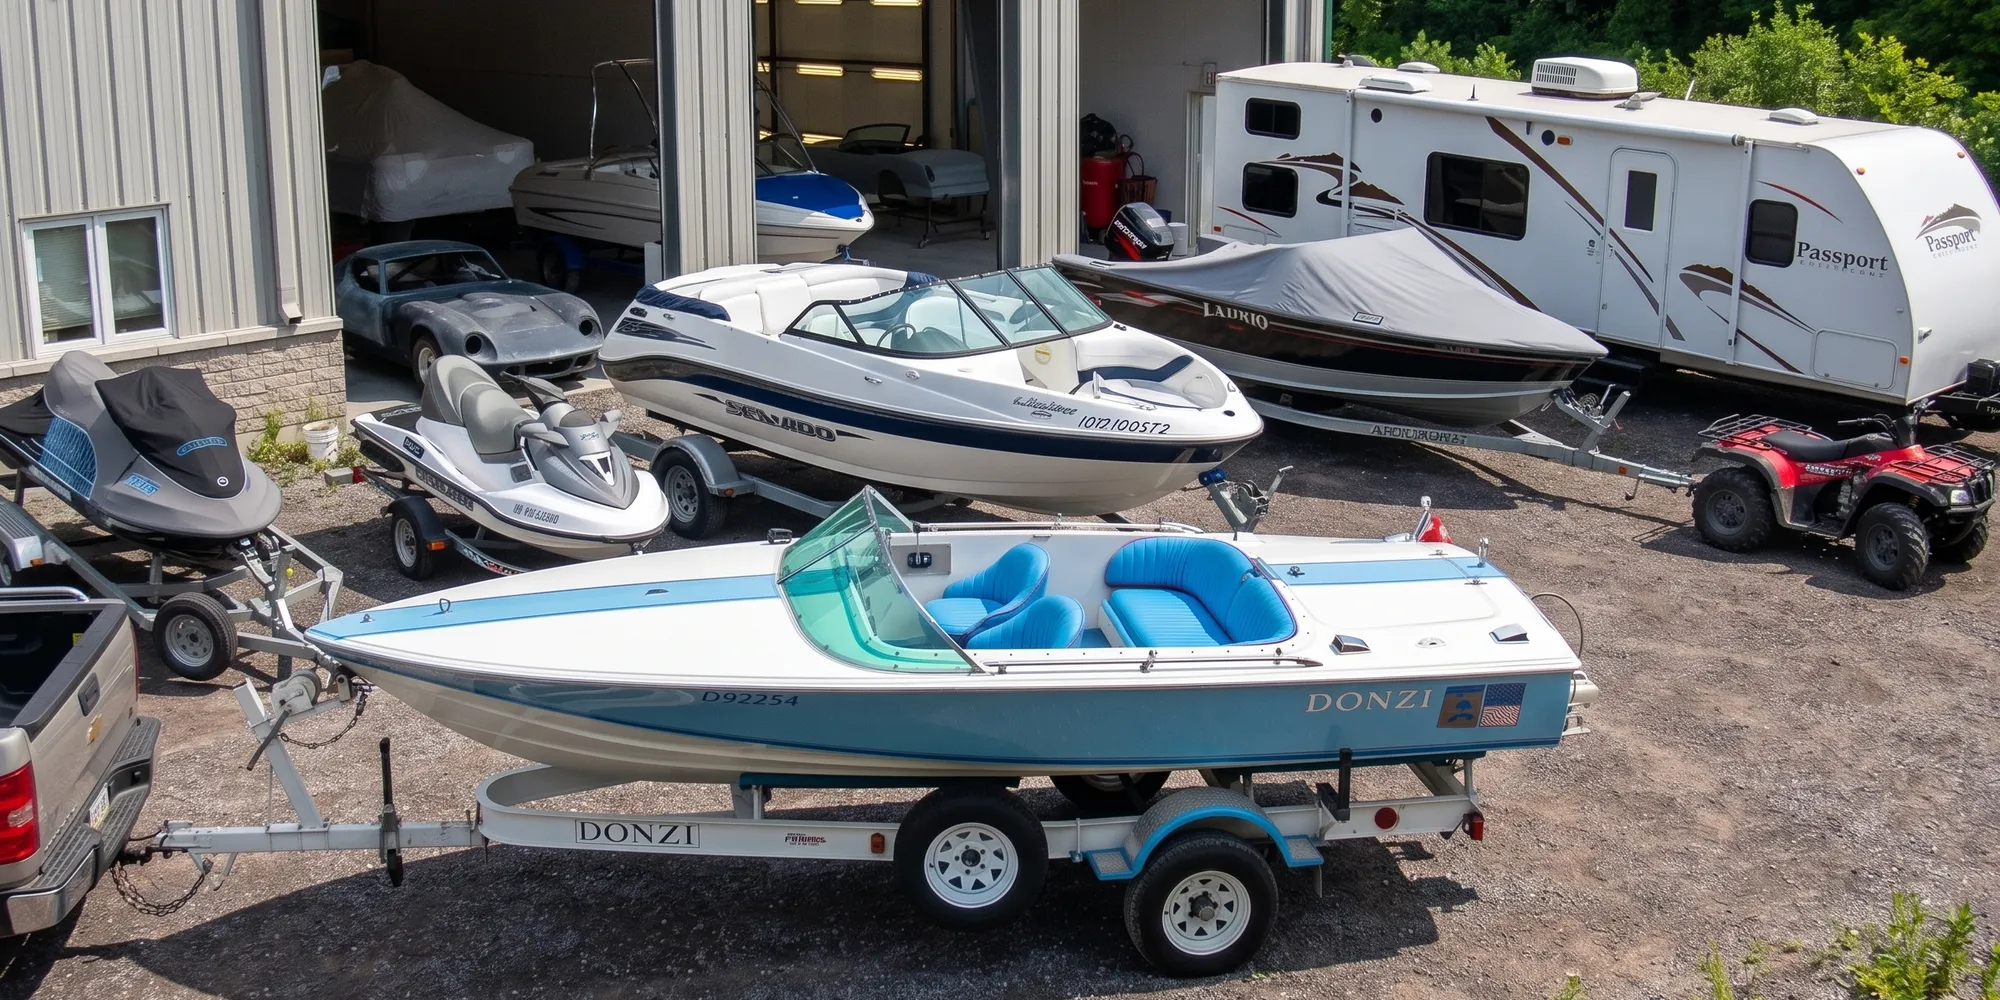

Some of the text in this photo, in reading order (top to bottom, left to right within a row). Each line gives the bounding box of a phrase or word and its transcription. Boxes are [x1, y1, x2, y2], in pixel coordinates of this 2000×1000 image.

[1797, 241, 1889, 272] Passport
[701, 691, 799, 707] D92254
[1305, 689, 1433, 713] DONZI
[580, 821, 695, 845] DONZI
